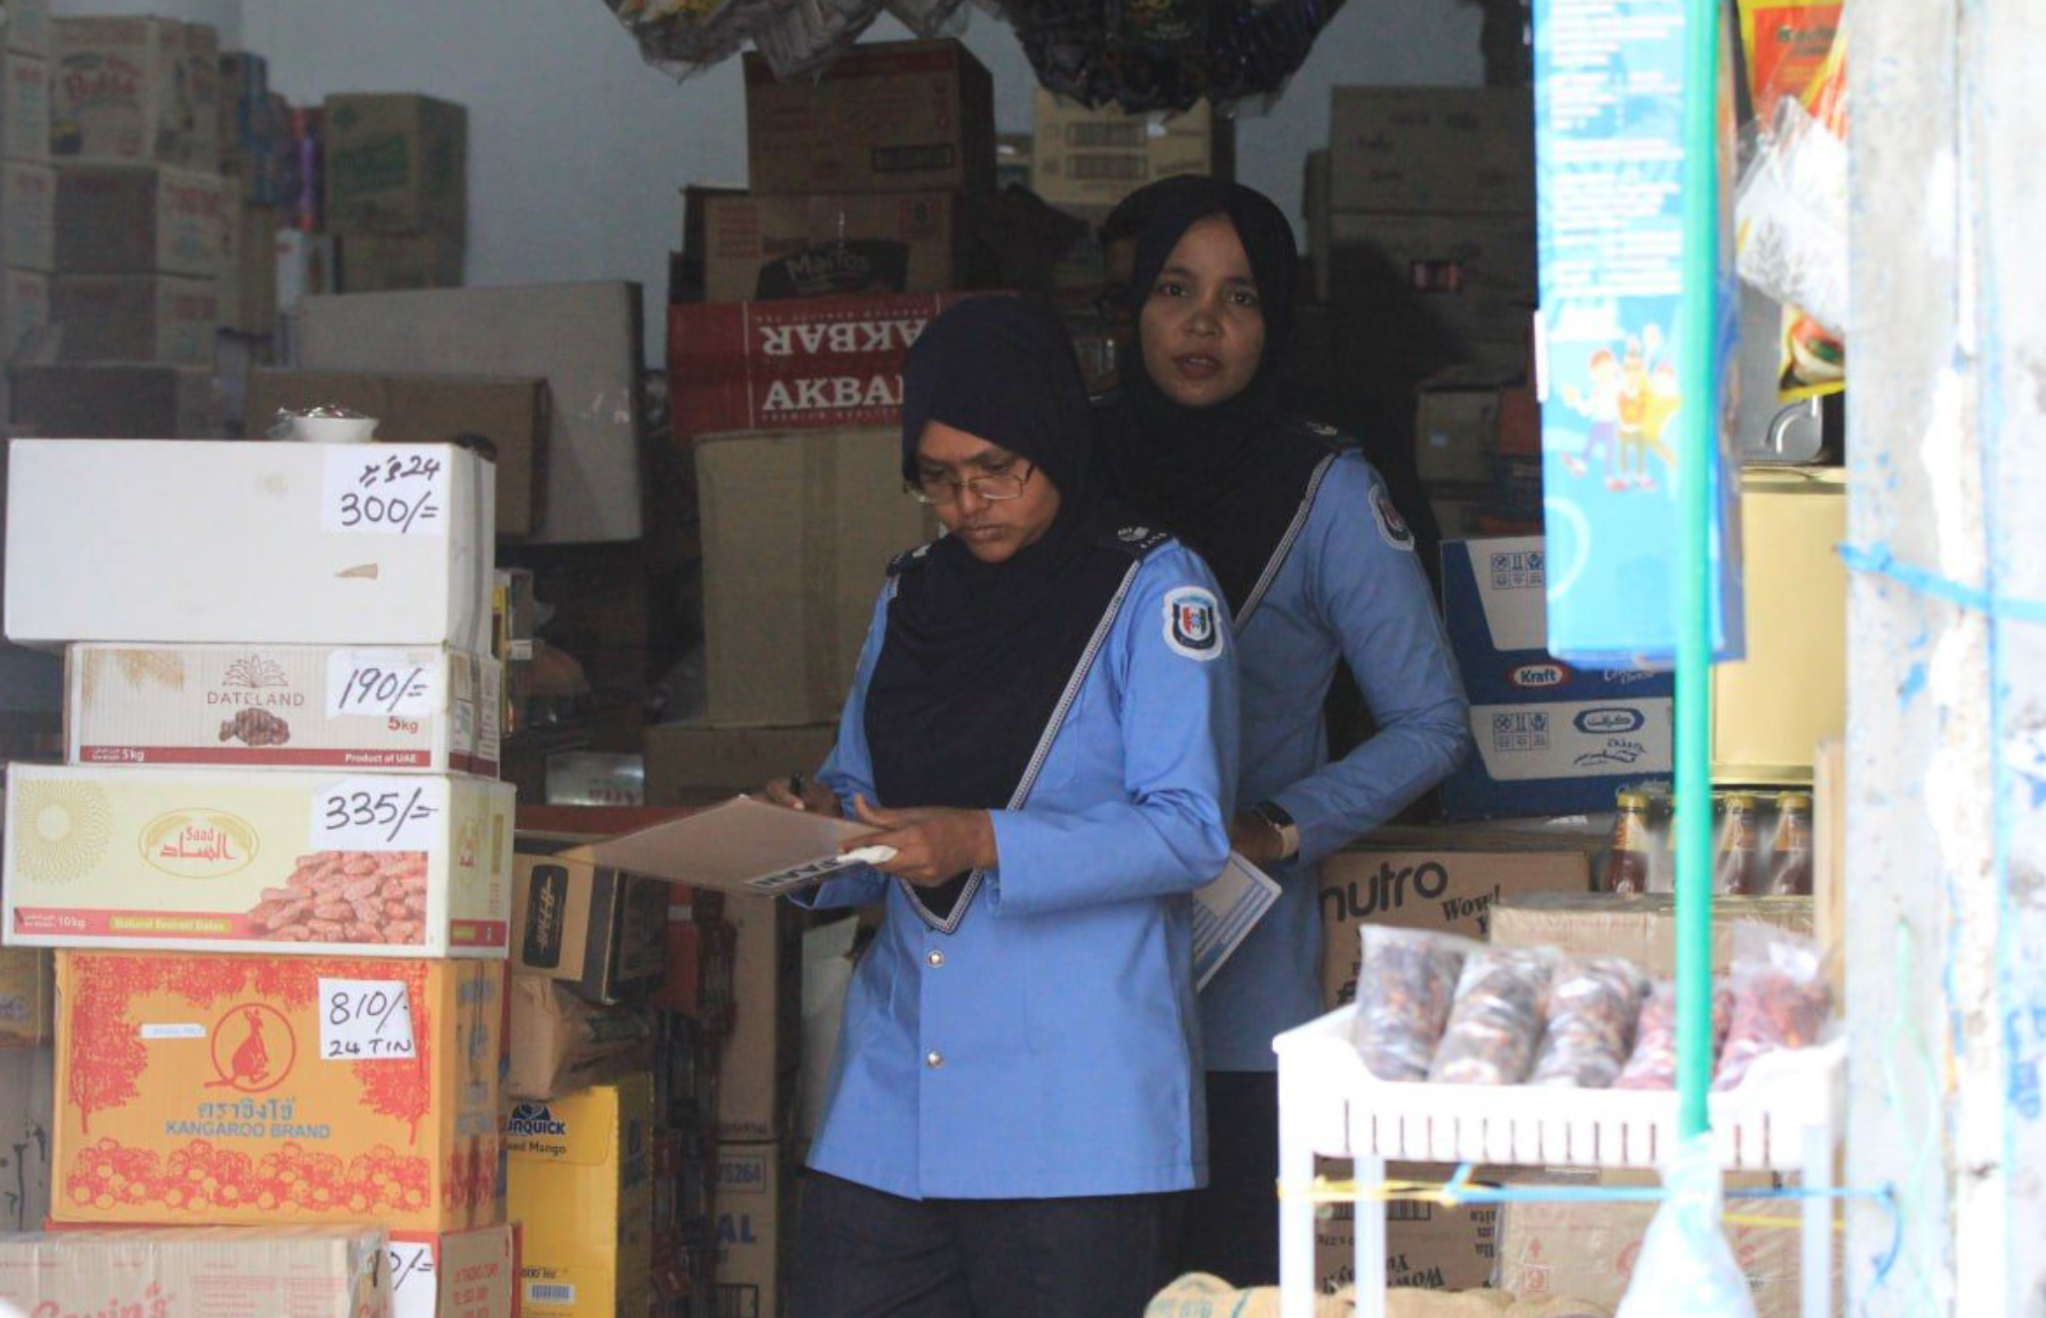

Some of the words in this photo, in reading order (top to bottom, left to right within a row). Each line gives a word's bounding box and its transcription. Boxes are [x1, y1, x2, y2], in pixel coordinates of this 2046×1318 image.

[759, 318, 930, 356] AKBAR
[762, 373, 904, 410] AKBA
[1520, 669, 1557, 684] Kraft
[206, 691, 305, 706] DATELAND
[345, 753, 382, 763] Product
[325, 787, 439, 843] 335/=
[186, 827, 214, 842] Saad
[1321, 861, 1449, 922] nutro
[328, 1039, 361, 1057] 24
[367, 1038, 412, 1055] TIN
[165, 1121, 266, 1138] KANGAROO
[271, 1123, 331, 1139] BRAND
[529, 1141, 566, 1156] Mango
